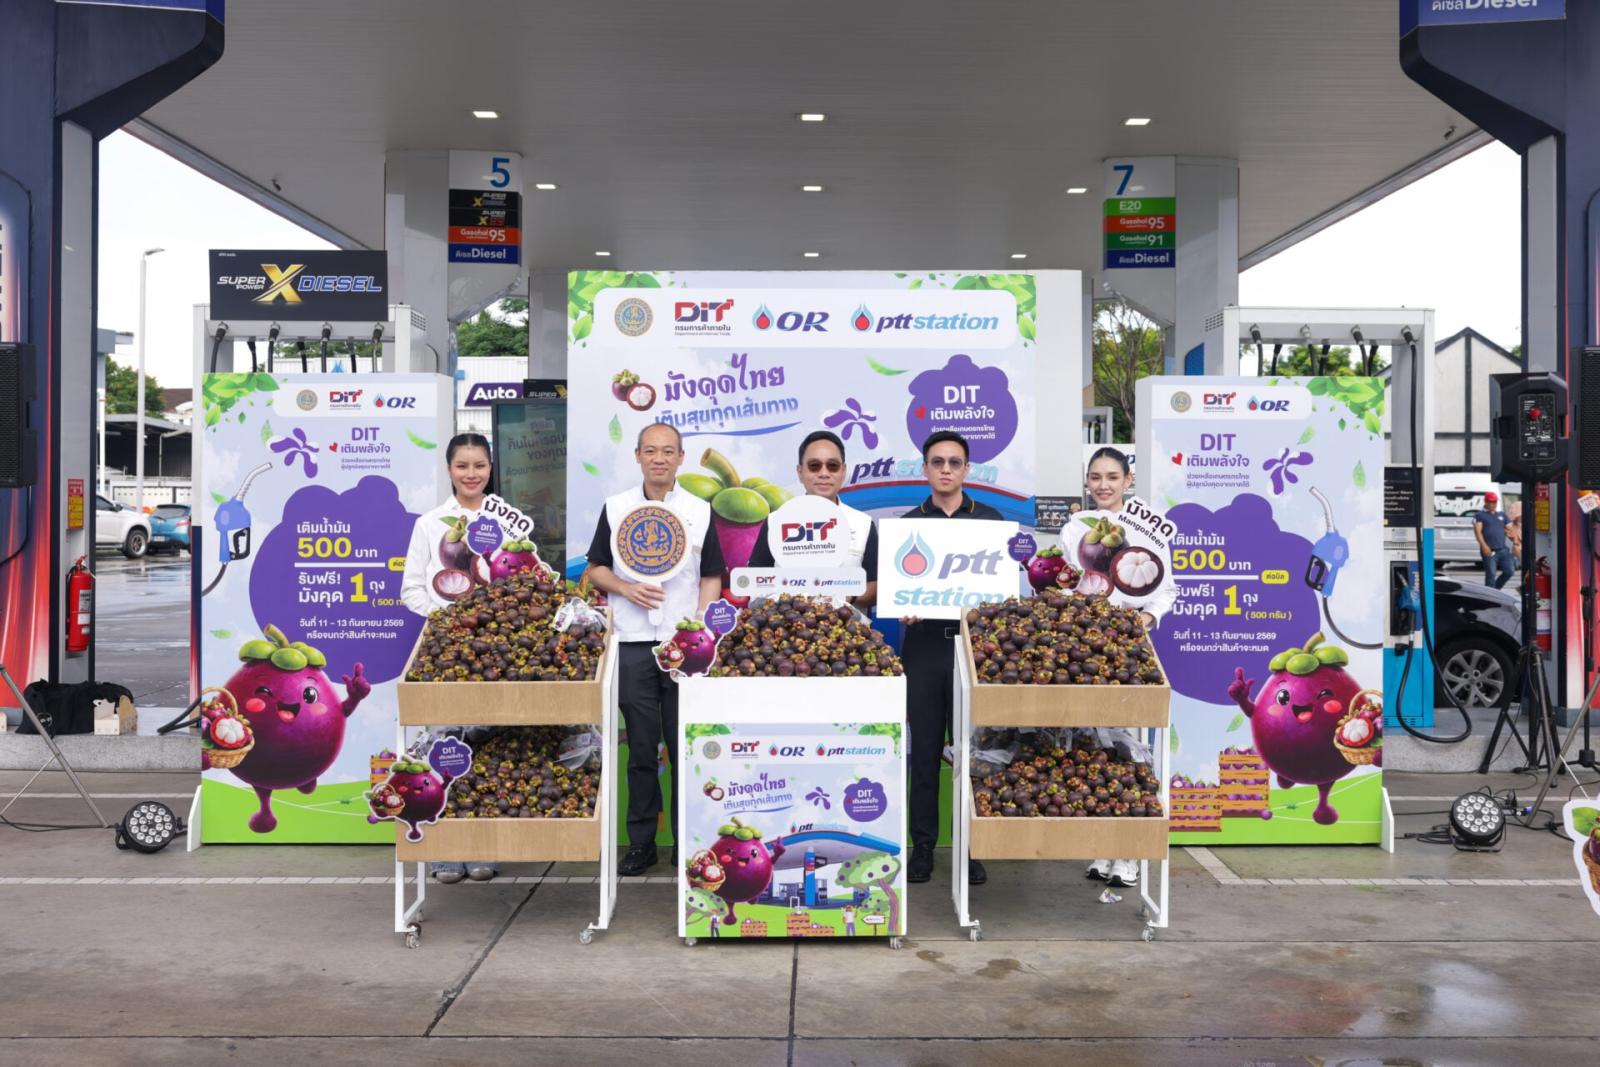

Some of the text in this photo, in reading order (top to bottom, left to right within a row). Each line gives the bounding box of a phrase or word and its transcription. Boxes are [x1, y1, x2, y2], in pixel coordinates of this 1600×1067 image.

[490, 157, 510, 188] 5
[1113, 164, 1134, 196] 7
[1120, 201, 1141, 210] E20
[1120, 217, 1165, 229] Gasohol 95
[489, 230, 506, 241] 95
[1148, 234, 1164, 246] 91
[472, 248, 506, 259] Diesel
[1135, 253, 1169, 263] Diesel
[217, 264, 382, 302] SUPER X DIESEL
[777, 311, 830, 332] OR
[664, 352, 785, 405] มังคุดไทย
[473, 387, 517, 400] Auto
[944, 385, 980, 404] DIT
[387, 397, 416, 408] OR
[1260, 400, 1290, 411] OR
[655, 396, 799, 431] เติมสุขทุกเส้นทาง
[930, 406, 995, 420] เติมพลังใจ
[351, 427, 380, 441] DIT
[341, 443, 391, 454] เติมพลังใจ
[1201, 433, 1236, 451] DIT
[1187, 454, 1250, 467] เติมพลังใจ
[850, 456, 895, 484] ptt
[484, 497, 530, 532] มังคุด
[1126, 500, 1173, 537] มังคุด
[297, 517, 351, 534] เติมน้ำมัน
[481, 523, 493, 532] DIT
[1118, 514, 1165, 549] Mangosteen
[1171, 530, 1225, 546] เติมน้ำมัน
[297, 537, 378, 558] 500 บาท
[937, 548, 1003, 580] ptt
[1172, 549, 1251, 571] 500 บาท
[298, 572, 341, 585] รับฟรี!
[790, 579, 806, 587] OR
[350, 572, 385, 603] 1 ถุง
[299, 587, 344, 608] มังคุด
[1223, 585, 1259, 615] 1 ถุง
[1172, 600, 1217, 621] มังคุด
[1268, 611, 1286, 619] กรัม
[299, 616, 317, 627] วันที่
[318, 619, 328, 627] 11
[336, 619, 347, 627] 13
[349, 618, 382, 627] กันยายน
[1173, 628, 1190, 640] วันที่
[1192, 632, 1201, 640] 11
[1210, 632, 1220, 640] 13
[1221, 631, 1254, 640] กันยายน
[442, 746, 456, 755] DIT
[779, 746, 805, 757] OR
[728, 772, 786, 798] มังคุดไทย
[857, 789, 873, 798] DIT
[798, 822, 814, 833] ptt
